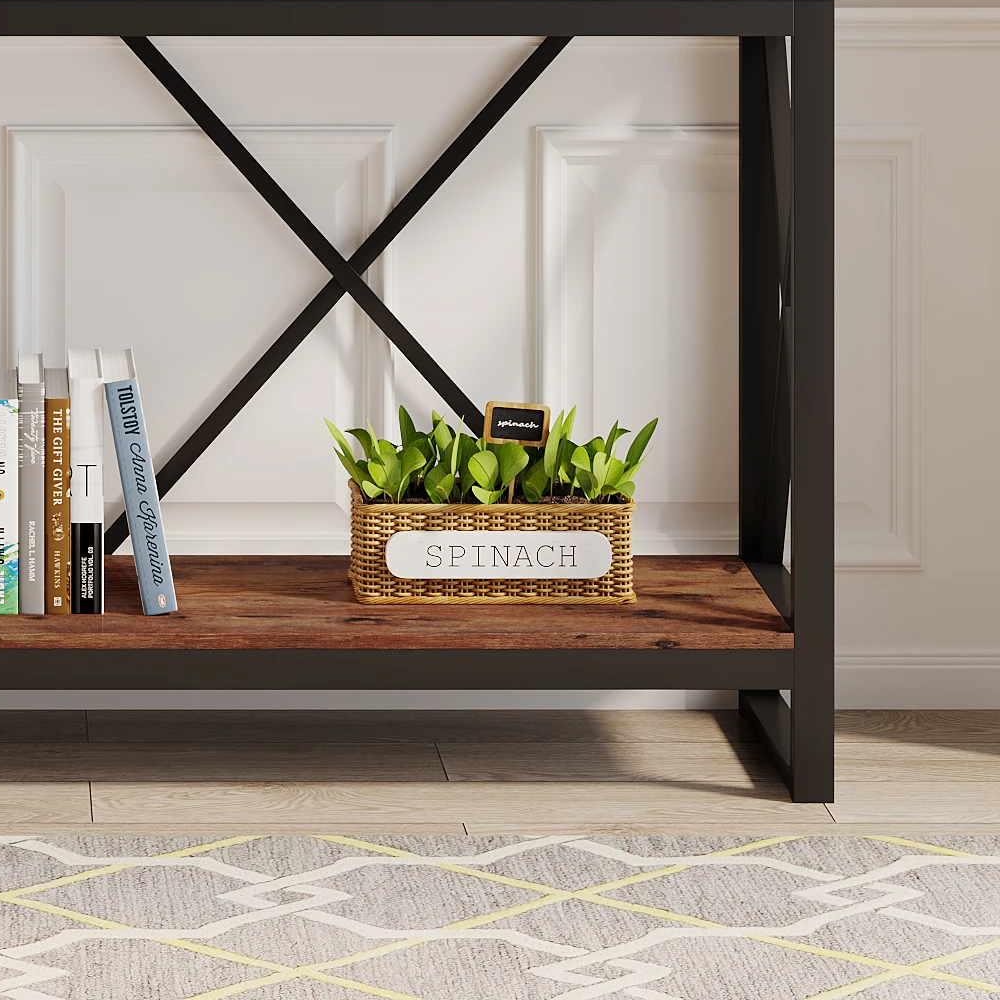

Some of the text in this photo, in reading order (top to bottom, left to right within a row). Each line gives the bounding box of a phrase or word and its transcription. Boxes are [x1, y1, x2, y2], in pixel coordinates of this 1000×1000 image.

[497, 419, 540, 429] spinach
[52, 409, 63, 506] THE GIFT GIVER
[117, 385, 165, 587] TOLSTOY Anna Karenina
[28, 520, 36, 549] RACHEL
[28, 557, 36, 582] HAMM
[425, 545, 578, 568] SPINACH
